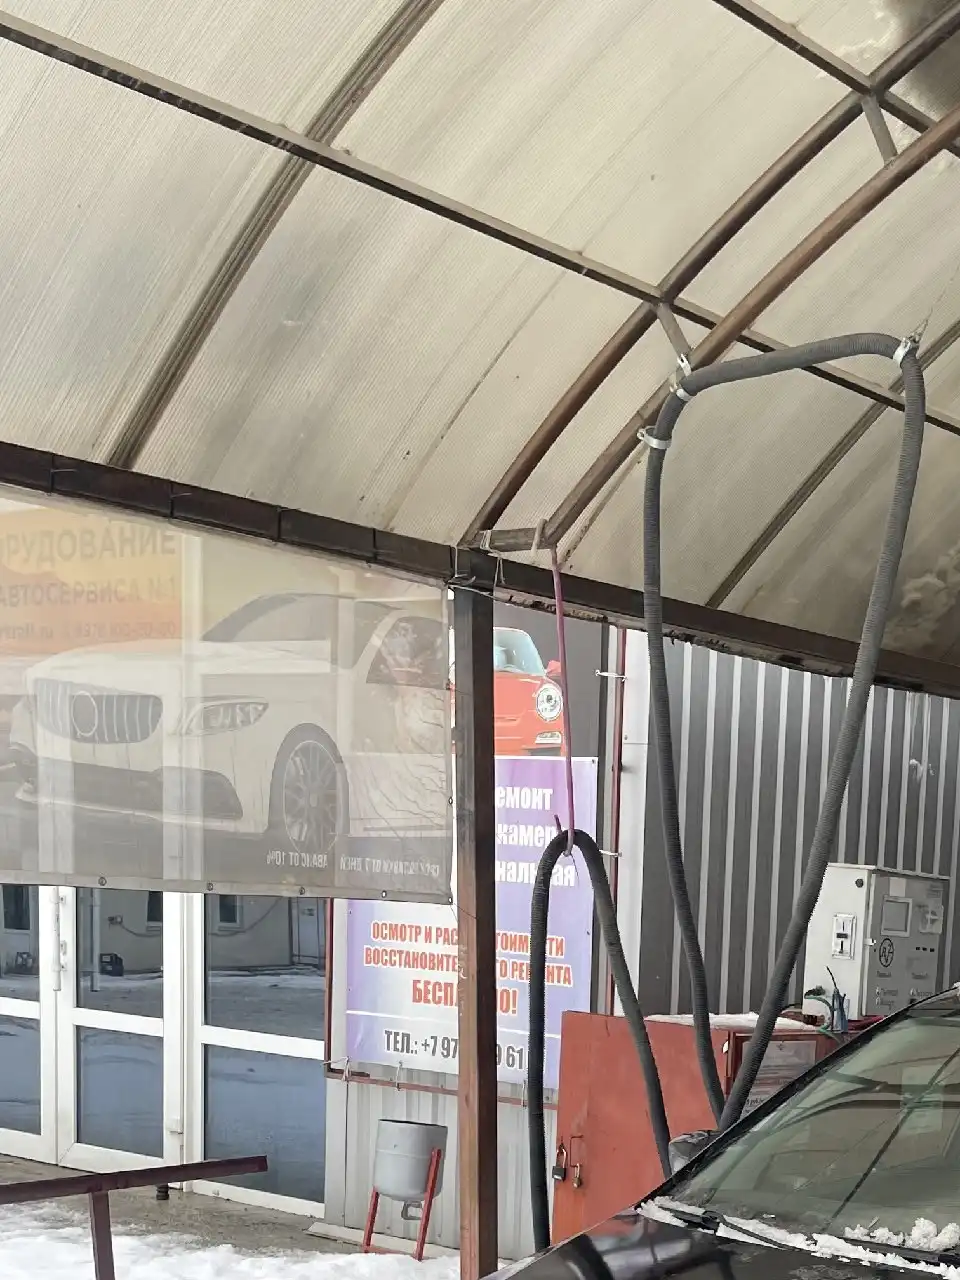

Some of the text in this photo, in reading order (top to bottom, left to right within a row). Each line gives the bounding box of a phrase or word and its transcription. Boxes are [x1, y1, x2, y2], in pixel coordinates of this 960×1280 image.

[0, 526, 176, 568] РУДОВАНИЕ
[496, 786, 553, 811] емонт
[496, 823, 559, 848] камер
[372, 922, 422, 944] ОСМОТР
[424, 925, 433, 944] И
[436, 927, 458, 946] РАС
[511, 962, 572, 985] РЕНТА
[384, 1029, 418, 1055] ТЕЛ.:
[441, 1036, 458, 1059] 97
